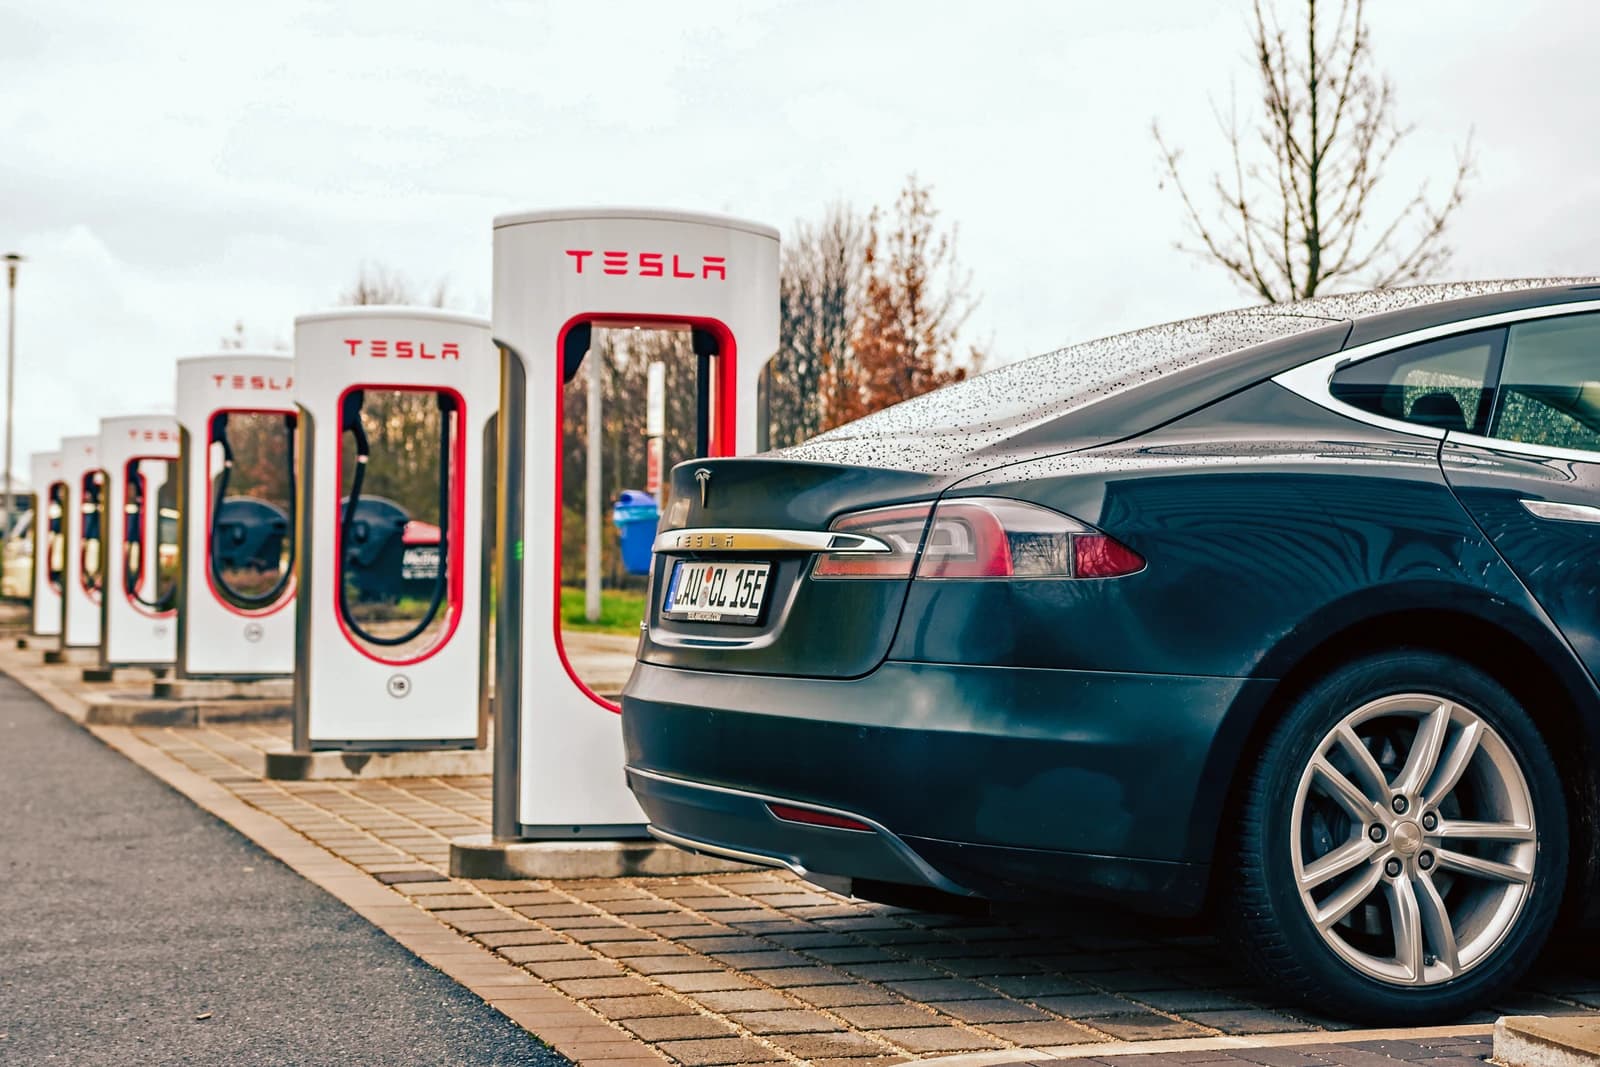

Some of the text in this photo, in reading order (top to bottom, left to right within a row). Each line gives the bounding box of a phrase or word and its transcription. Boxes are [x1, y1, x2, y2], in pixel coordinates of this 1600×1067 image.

[565, 250, 726, 281] TESLA
[343, 339, 460, 360] TESLA
[675, 535, 735, 548] TESLA
[708, 568, 728, 607] CL
[729, 568, 767, 609] 15E
